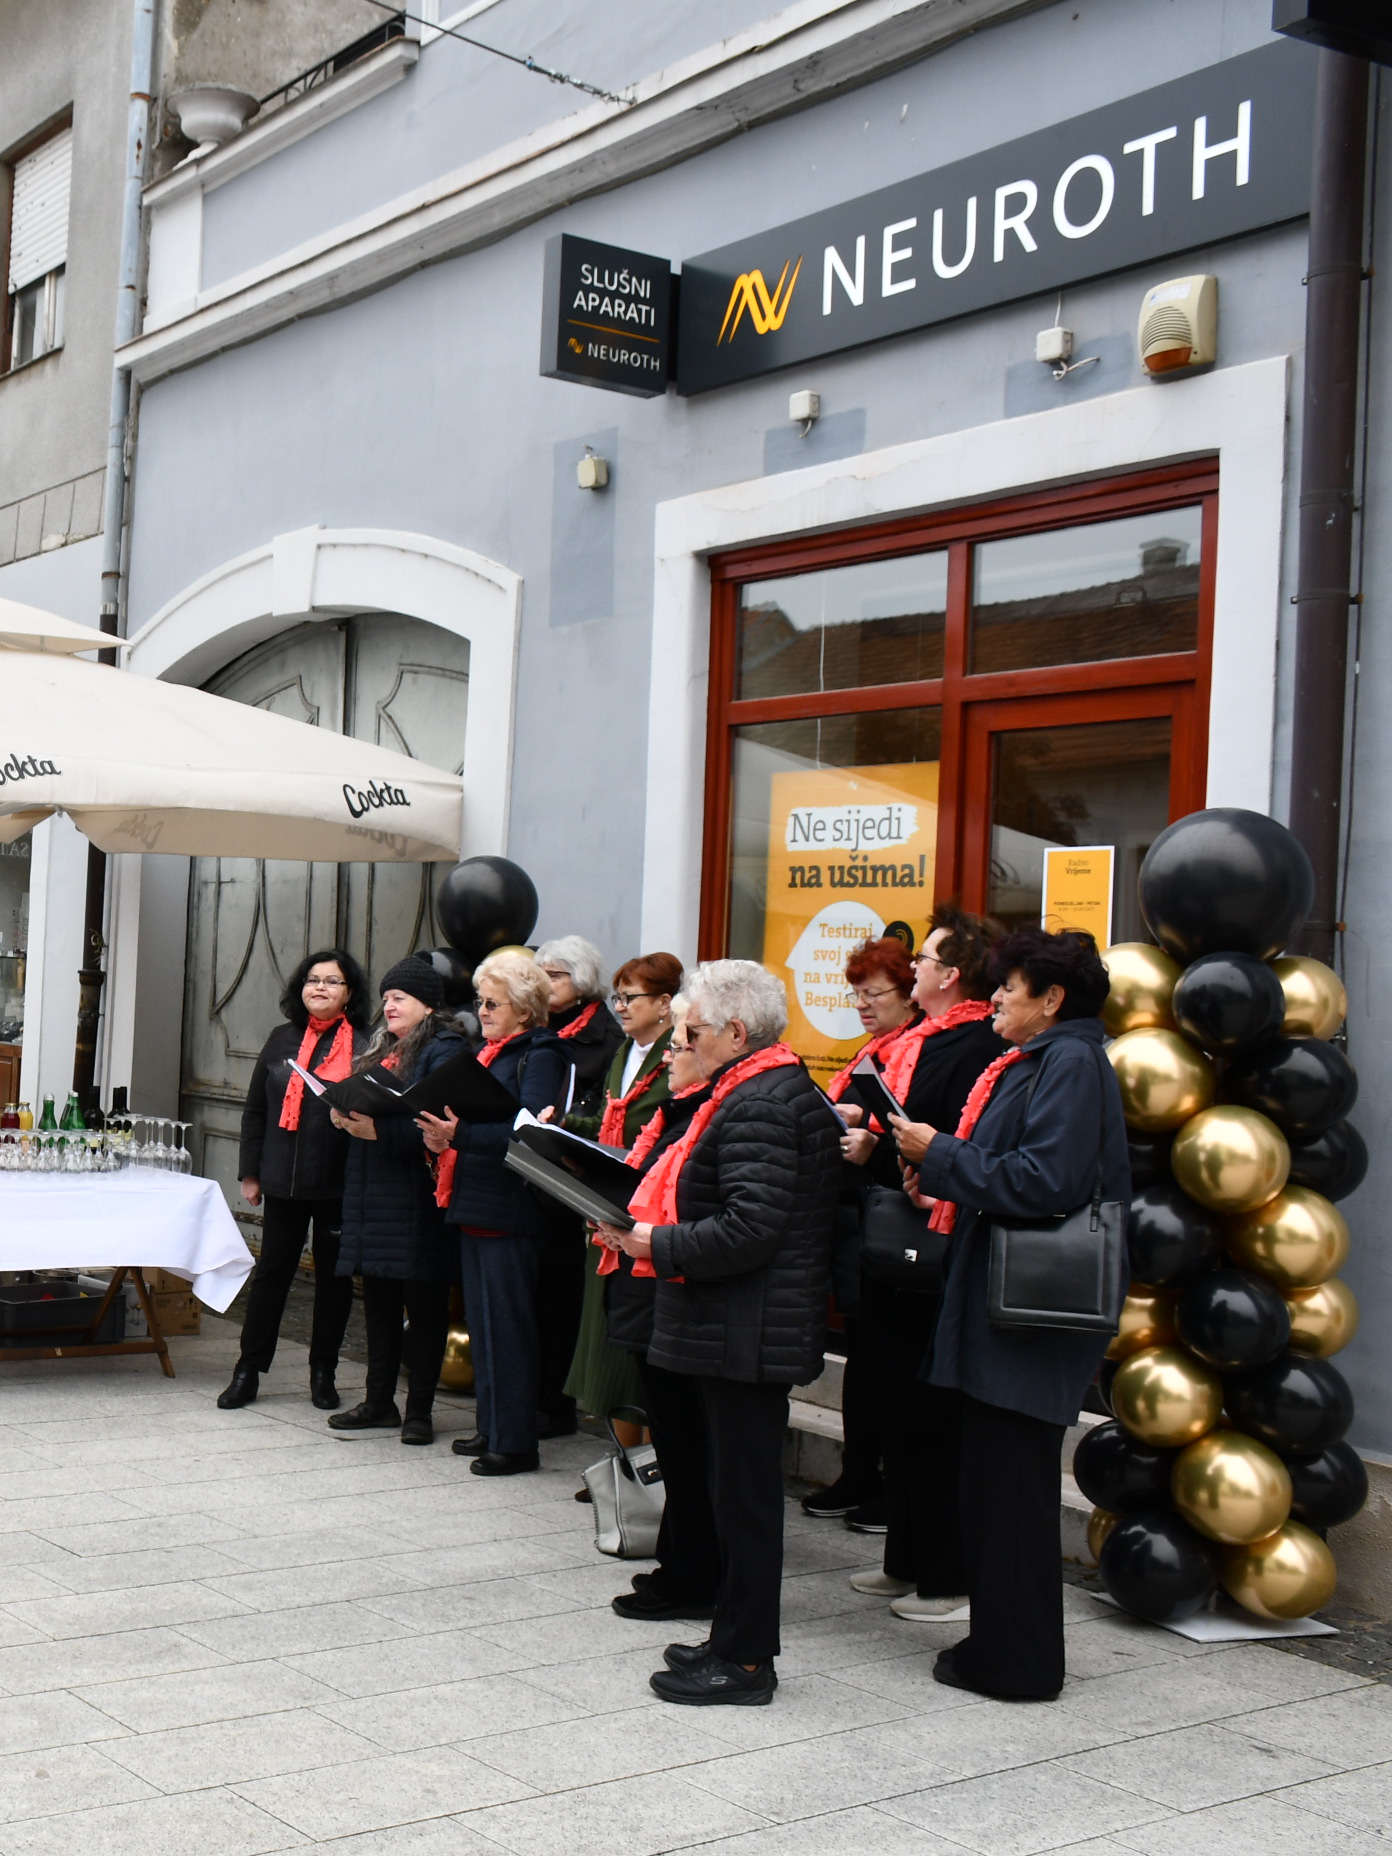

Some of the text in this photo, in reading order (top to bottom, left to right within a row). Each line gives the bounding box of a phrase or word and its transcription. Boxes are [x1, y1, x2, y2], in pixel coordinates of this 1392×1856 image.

[822, 99, 1251, 316] NEUROTH
[580, 263, 651, 299] SLUŠNI
[573, 290, 655, 327] APARATI
[587, 342, 660, 372] NEUROTH
[341, 780, 411, 818] Cockta
[790, 806, 903, 852] Ne sijedi
[788, 854, 926, 888] na ušima!
[813, 945, 841, 966] svoj
[803, 969, 849, 989] na vrij
[804, 991, 854, 1012] Bespla
